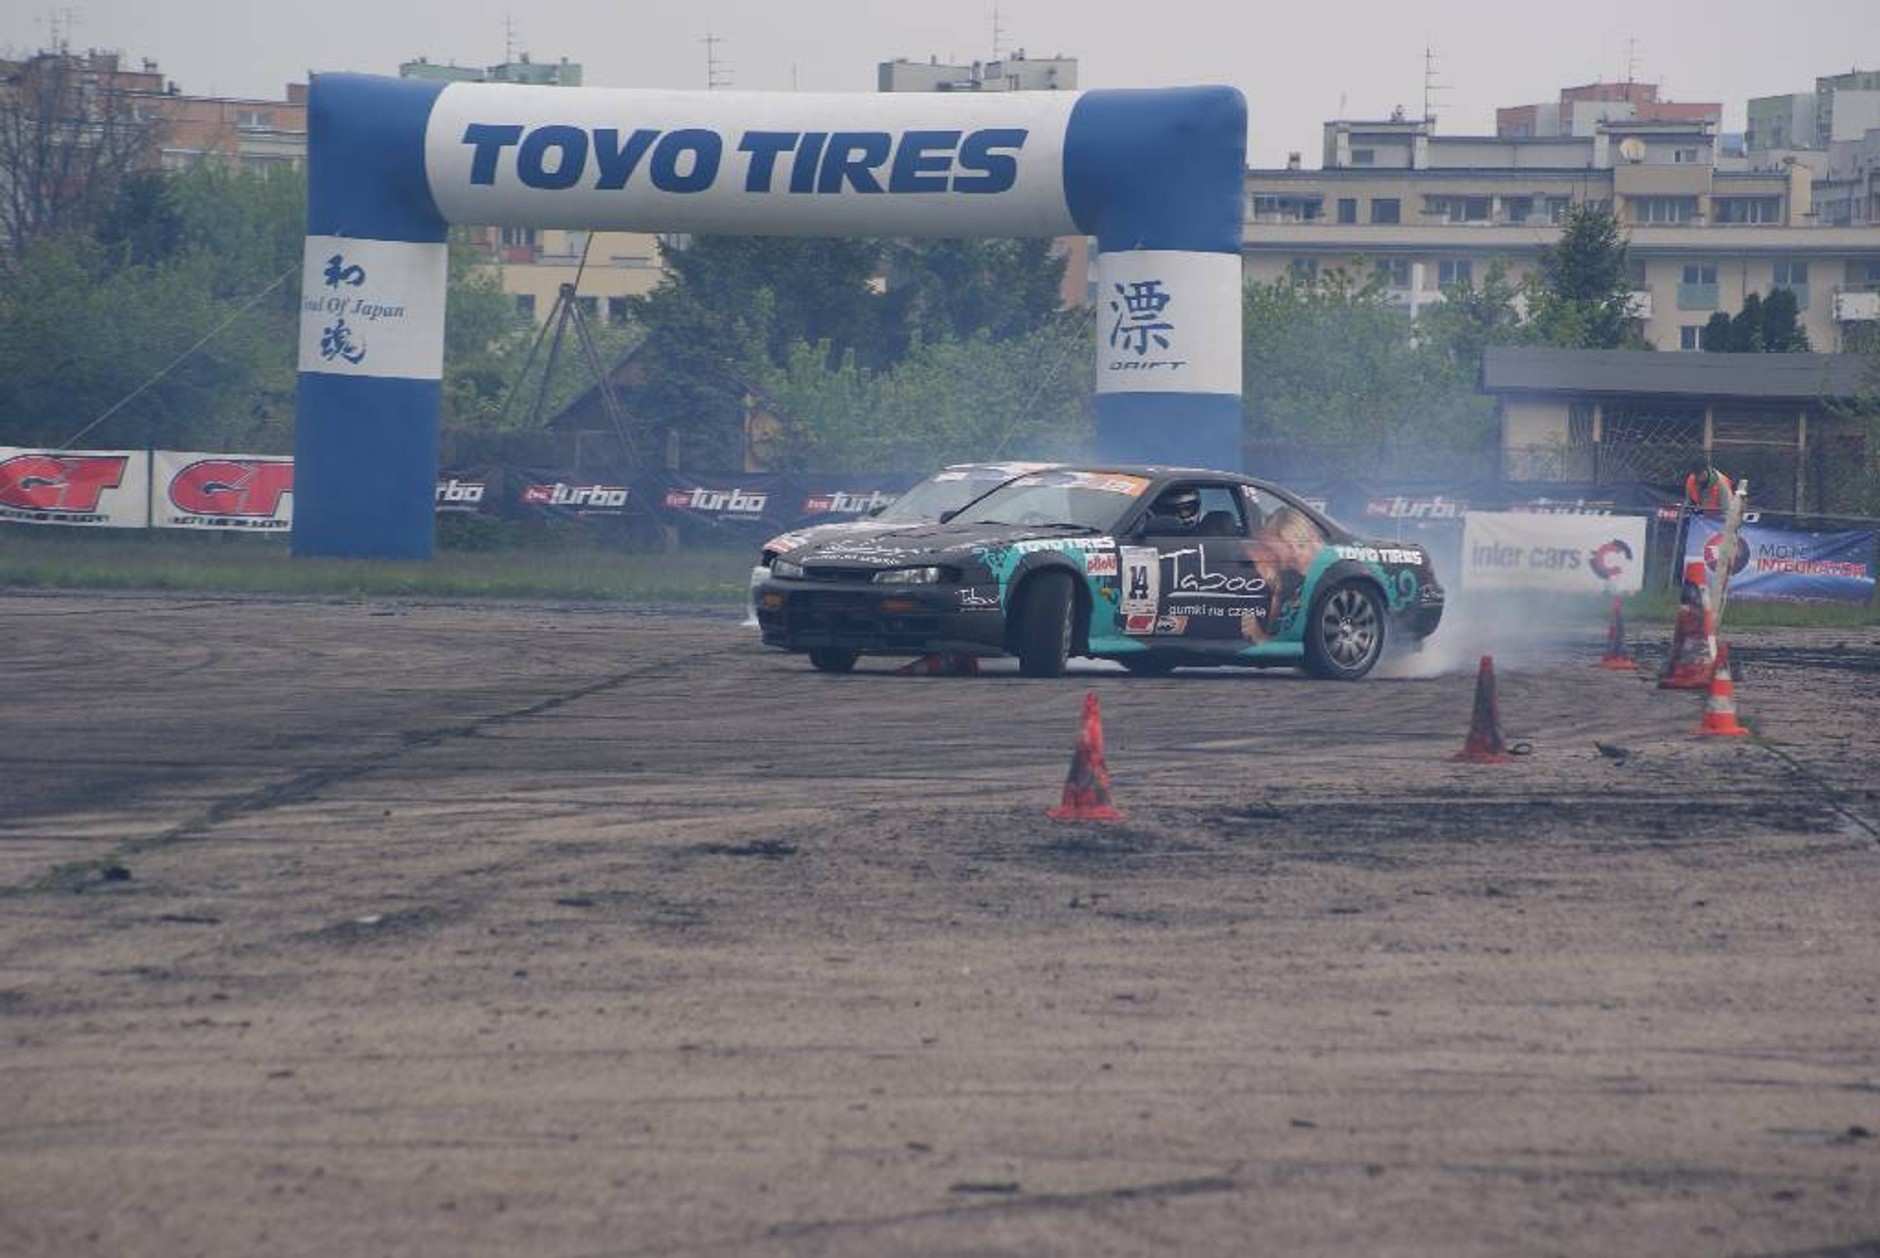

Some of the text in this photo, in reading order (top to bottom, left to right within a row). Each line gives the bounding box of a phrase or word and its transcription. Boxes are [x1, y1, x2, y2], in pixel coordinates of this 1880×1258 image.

[461, 123, 1029, 194] TOYO TIRES
[351, 299, 405, 320] Japan
[1110, 280, 1174, 355] 漂
[1110, 361, 1187, 371] DRIFT
[435, 479, 485, 501] rbo
[550, 483, 630, 506] turbo
[690, 487, 768, 512] turbo
[1337, 547, 1423, 565] TOYO TIRES
[1472, 540, 1582, 570] inter cars
[1160, 544, 1266, 591] Taboo
[1170, 604, 1206, 616] gumki
[1208, 607, 1225, 617] na
